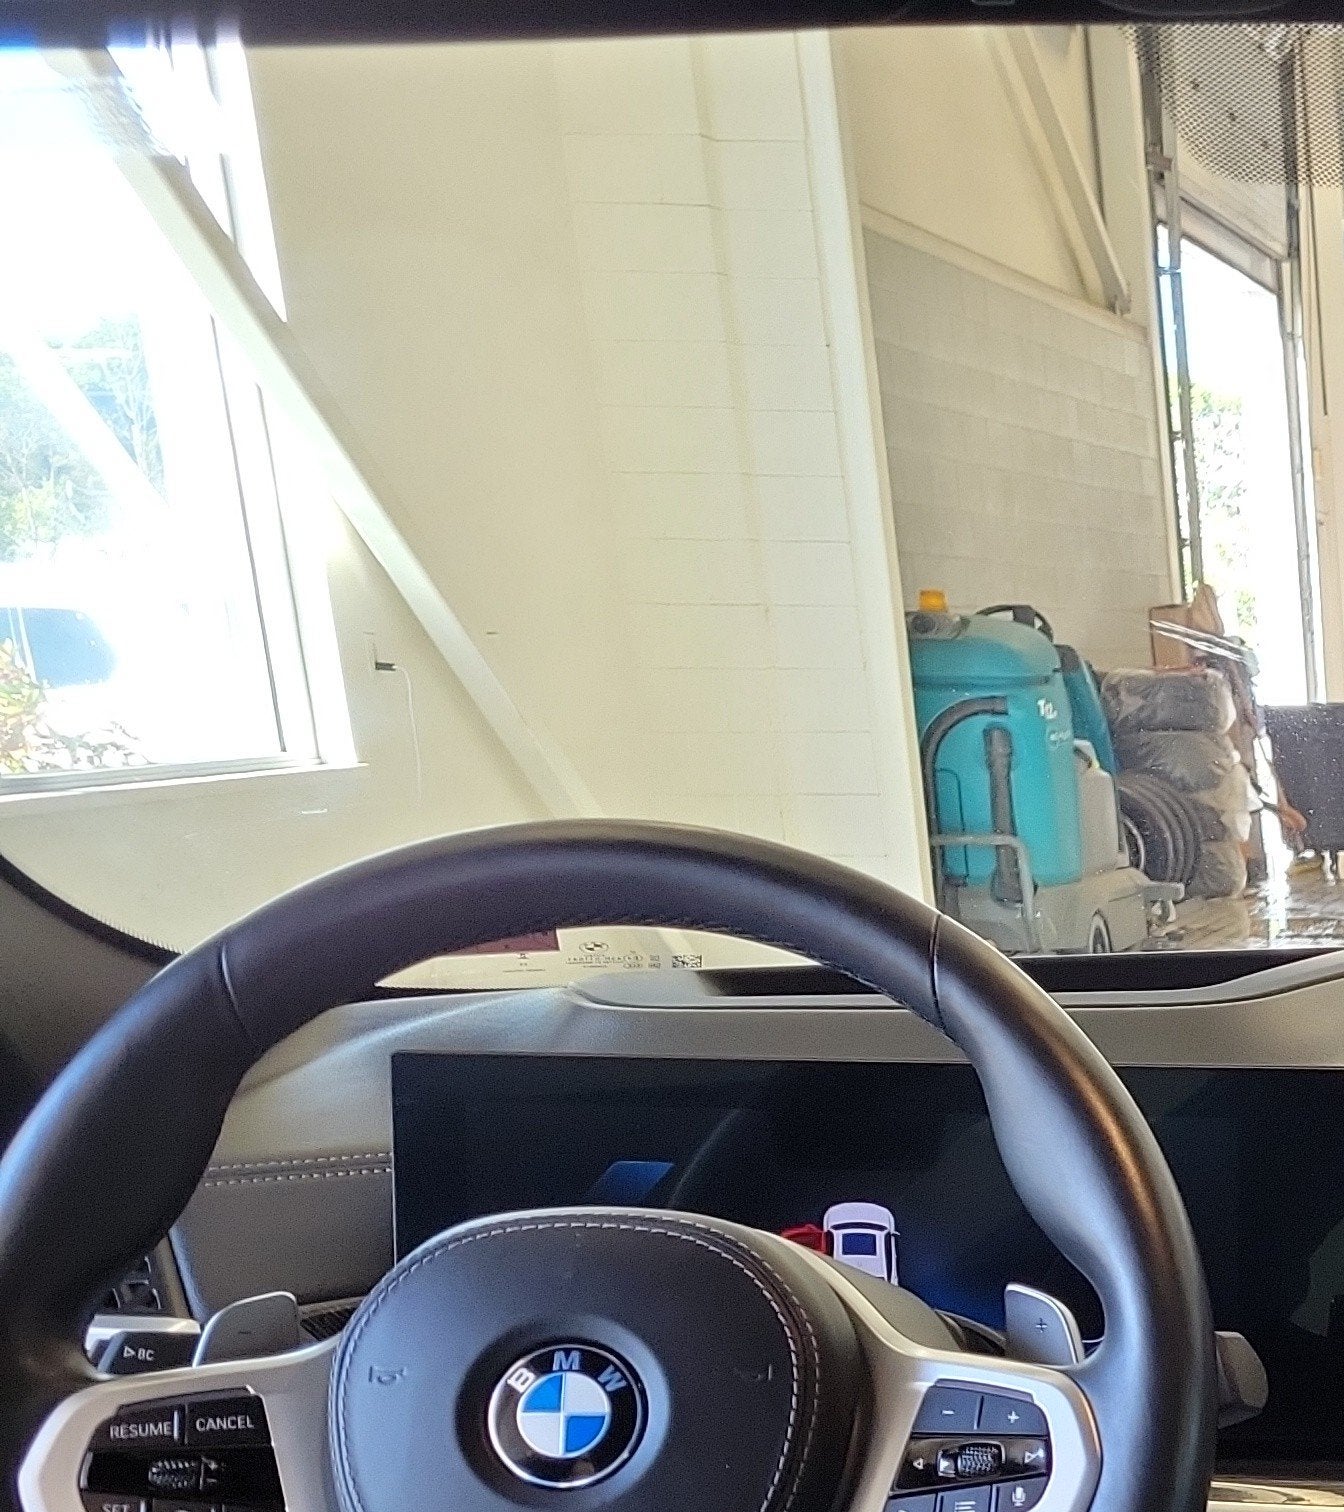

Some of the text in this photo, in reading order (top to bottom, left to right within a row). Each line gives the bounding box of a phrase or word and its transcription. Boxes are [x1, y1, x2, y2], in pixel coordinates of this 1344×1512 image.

[506, 1350, 628, 1394] BMW
[109, 1420, 172, 1440] RESUME
[195, 1414, 255, 1432] CANCEL
